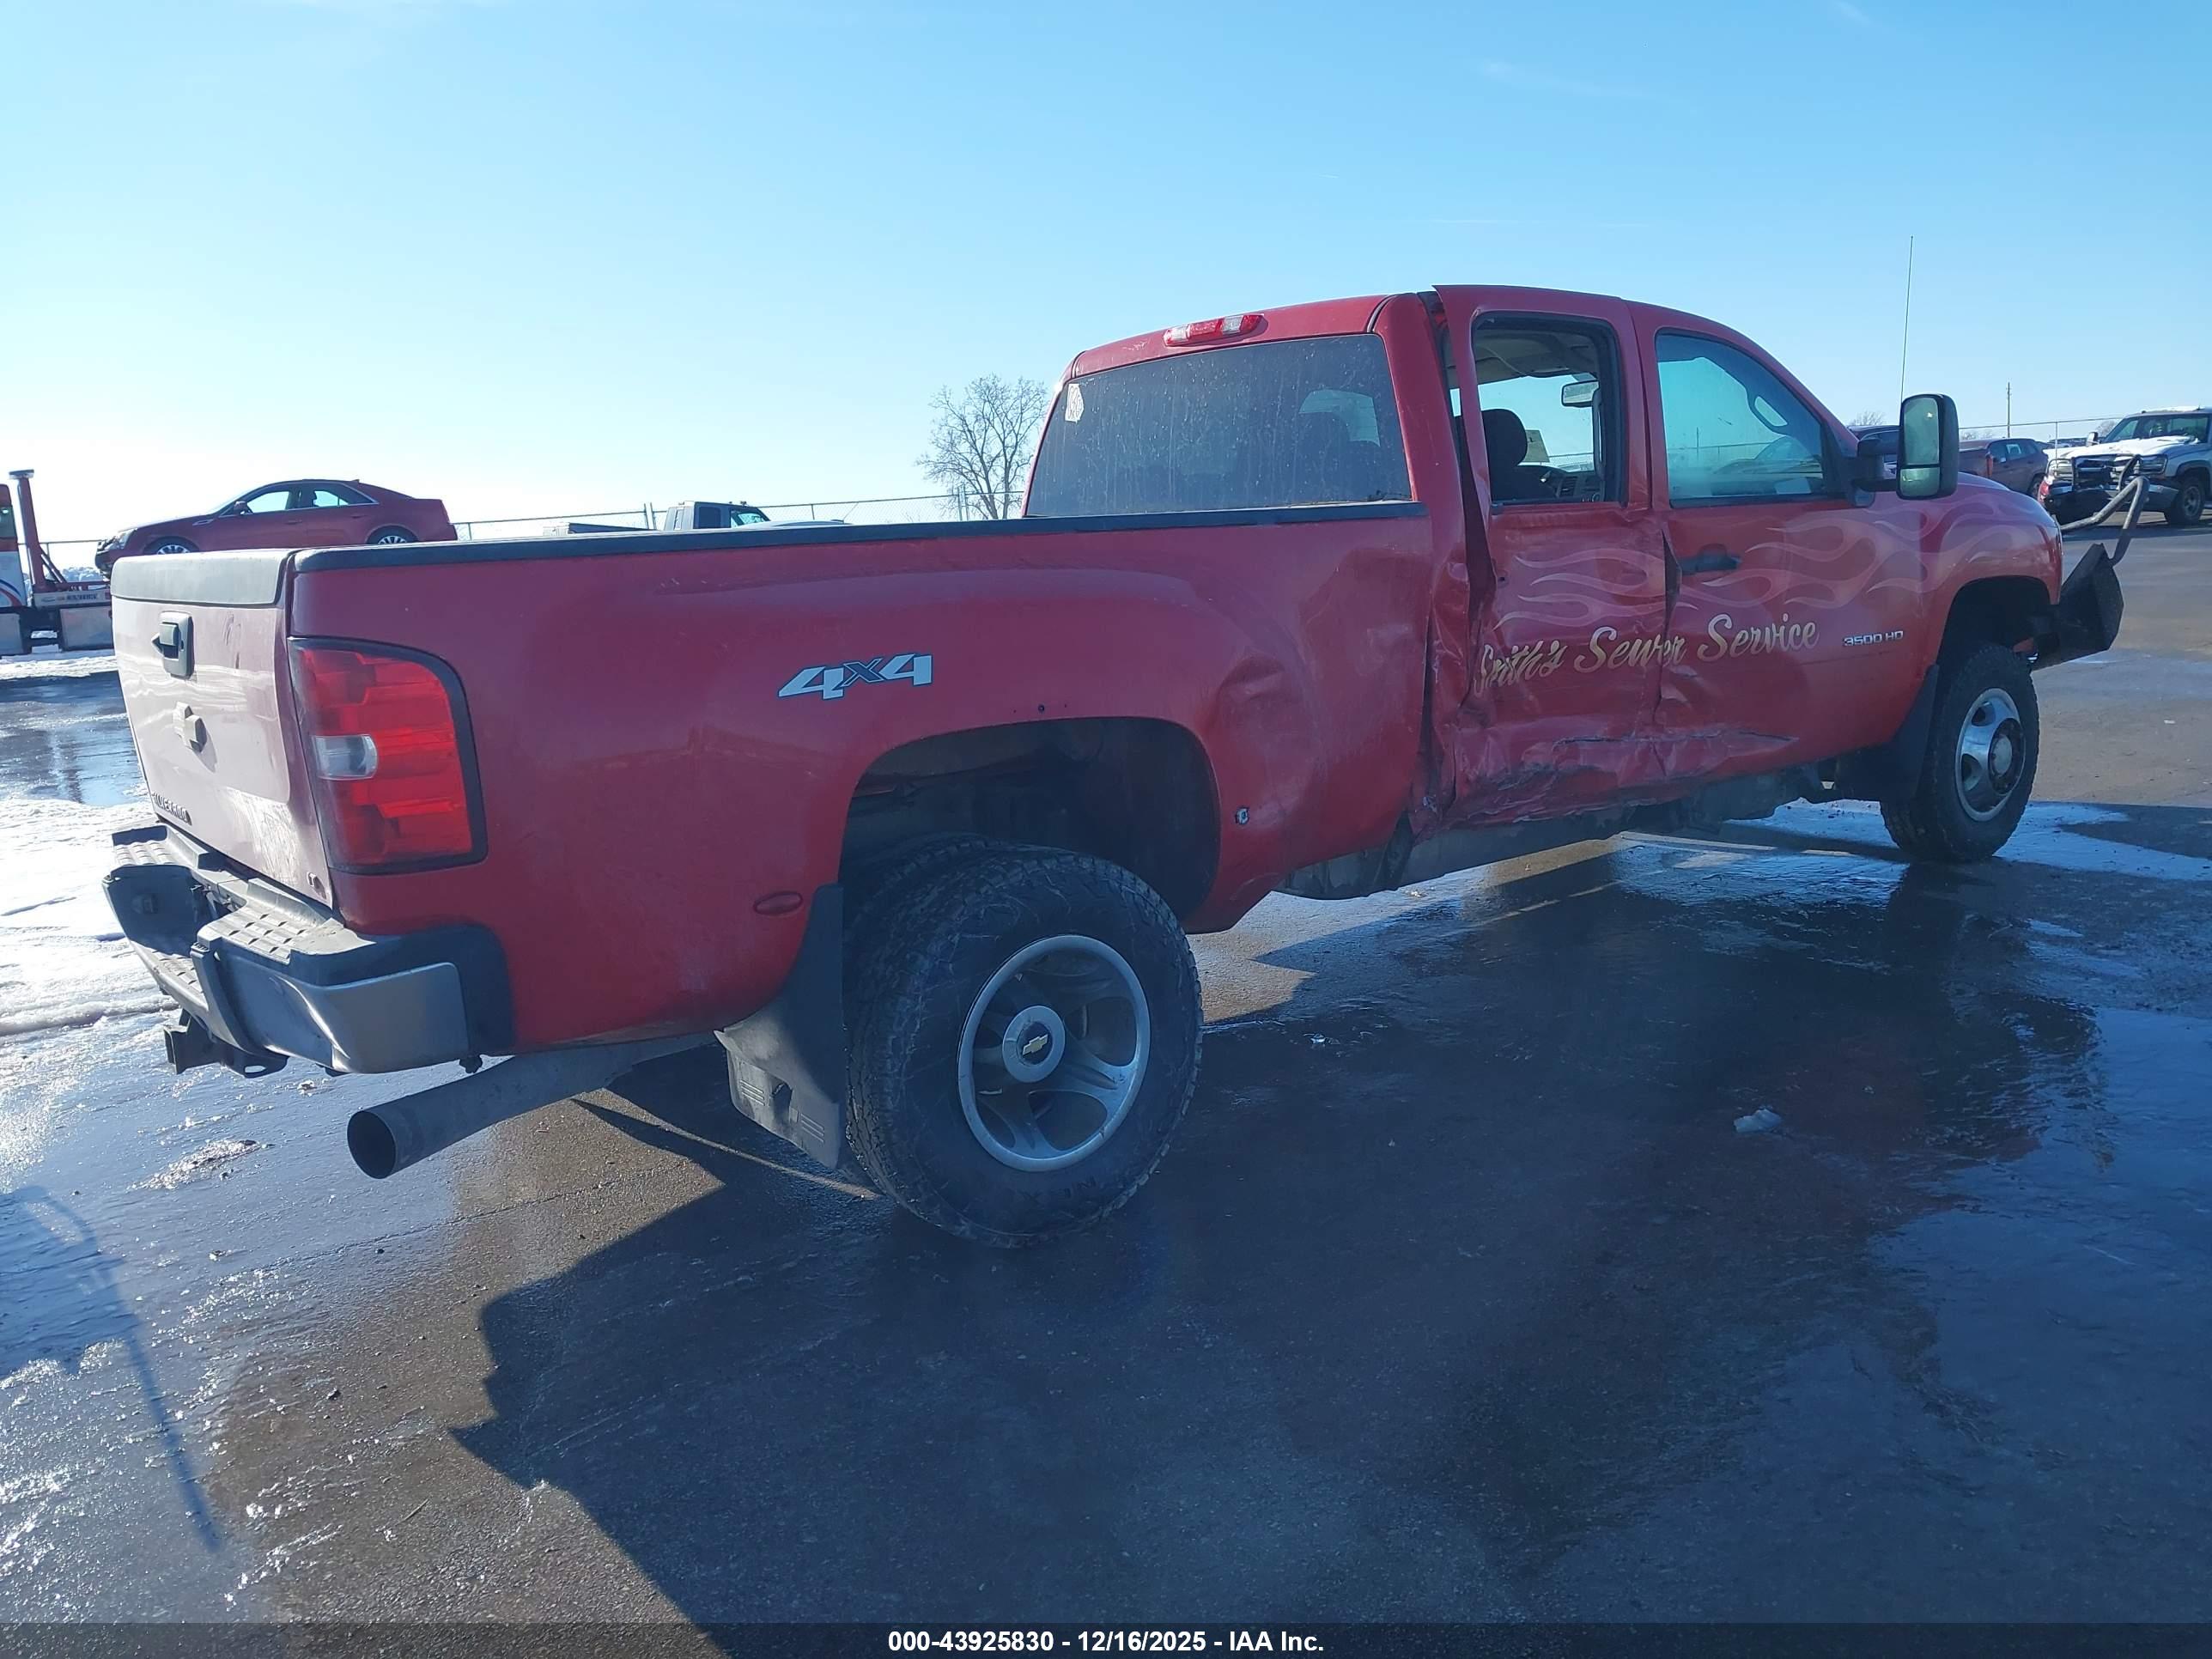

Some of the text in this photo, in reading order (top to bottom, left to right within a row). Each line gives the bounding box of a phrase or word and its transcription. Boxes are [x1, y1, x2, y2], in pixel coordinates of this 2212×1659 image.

[1573, 626, 1687, 673] Sewer
[1697, 613, 1820, 662] Service
[1843, 630, 1904, 647] 3500 HD
